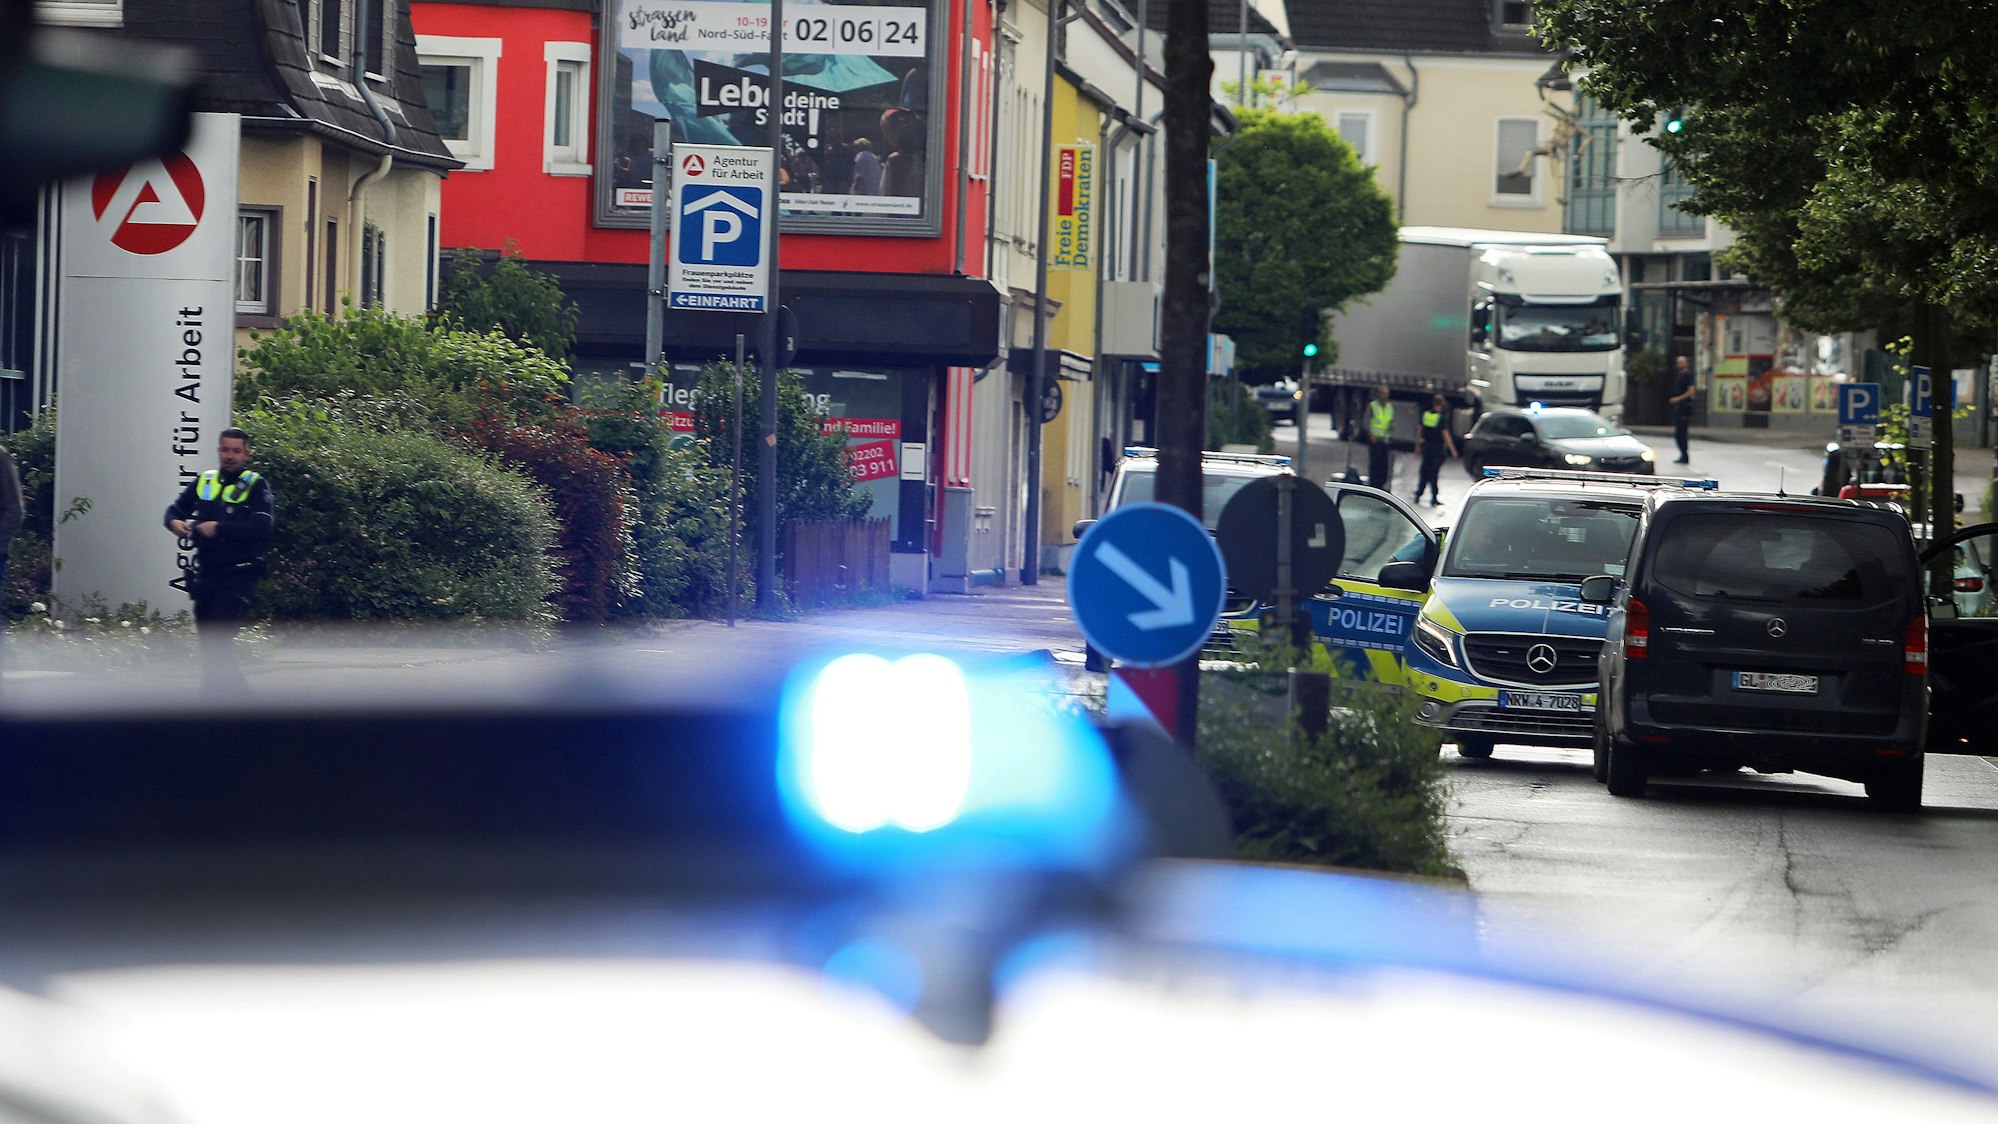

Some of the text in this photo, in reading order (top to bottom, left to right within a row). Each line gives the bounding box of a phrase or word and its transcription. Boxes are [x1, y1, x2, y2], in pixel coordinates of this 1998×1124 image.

[629, 4, 697, 30] strassen
[650, 24, 689, 43] land
[783, 91, 840, 110] deine
[712, 155, 759, 168] Agentur
[1061, 153, 1072, 179] FDP
[712, 168, 764, 180] für Arbeit
[1073, 148, 1092, 267] Demokraten
[701, 209, 743, 261] P
[1055, 220, 1073, 266] Freie
[687, 295, 759, 309] EINFAHRT
[175, 306, 204, 404] Arbeit
[1847, 388, 1871, 420] P
[172, 411, 199, 457] für
[845, 421, 896, 435] Familie!
[870, 459, 895, 475] 911
[1488, 598, 1593, 615] POLIZEI
[1328, 607, 1404, 635] POLIZEI
[1739, 672, 1758, 688] GL
[1506, 691, 1530, 708] NRW
